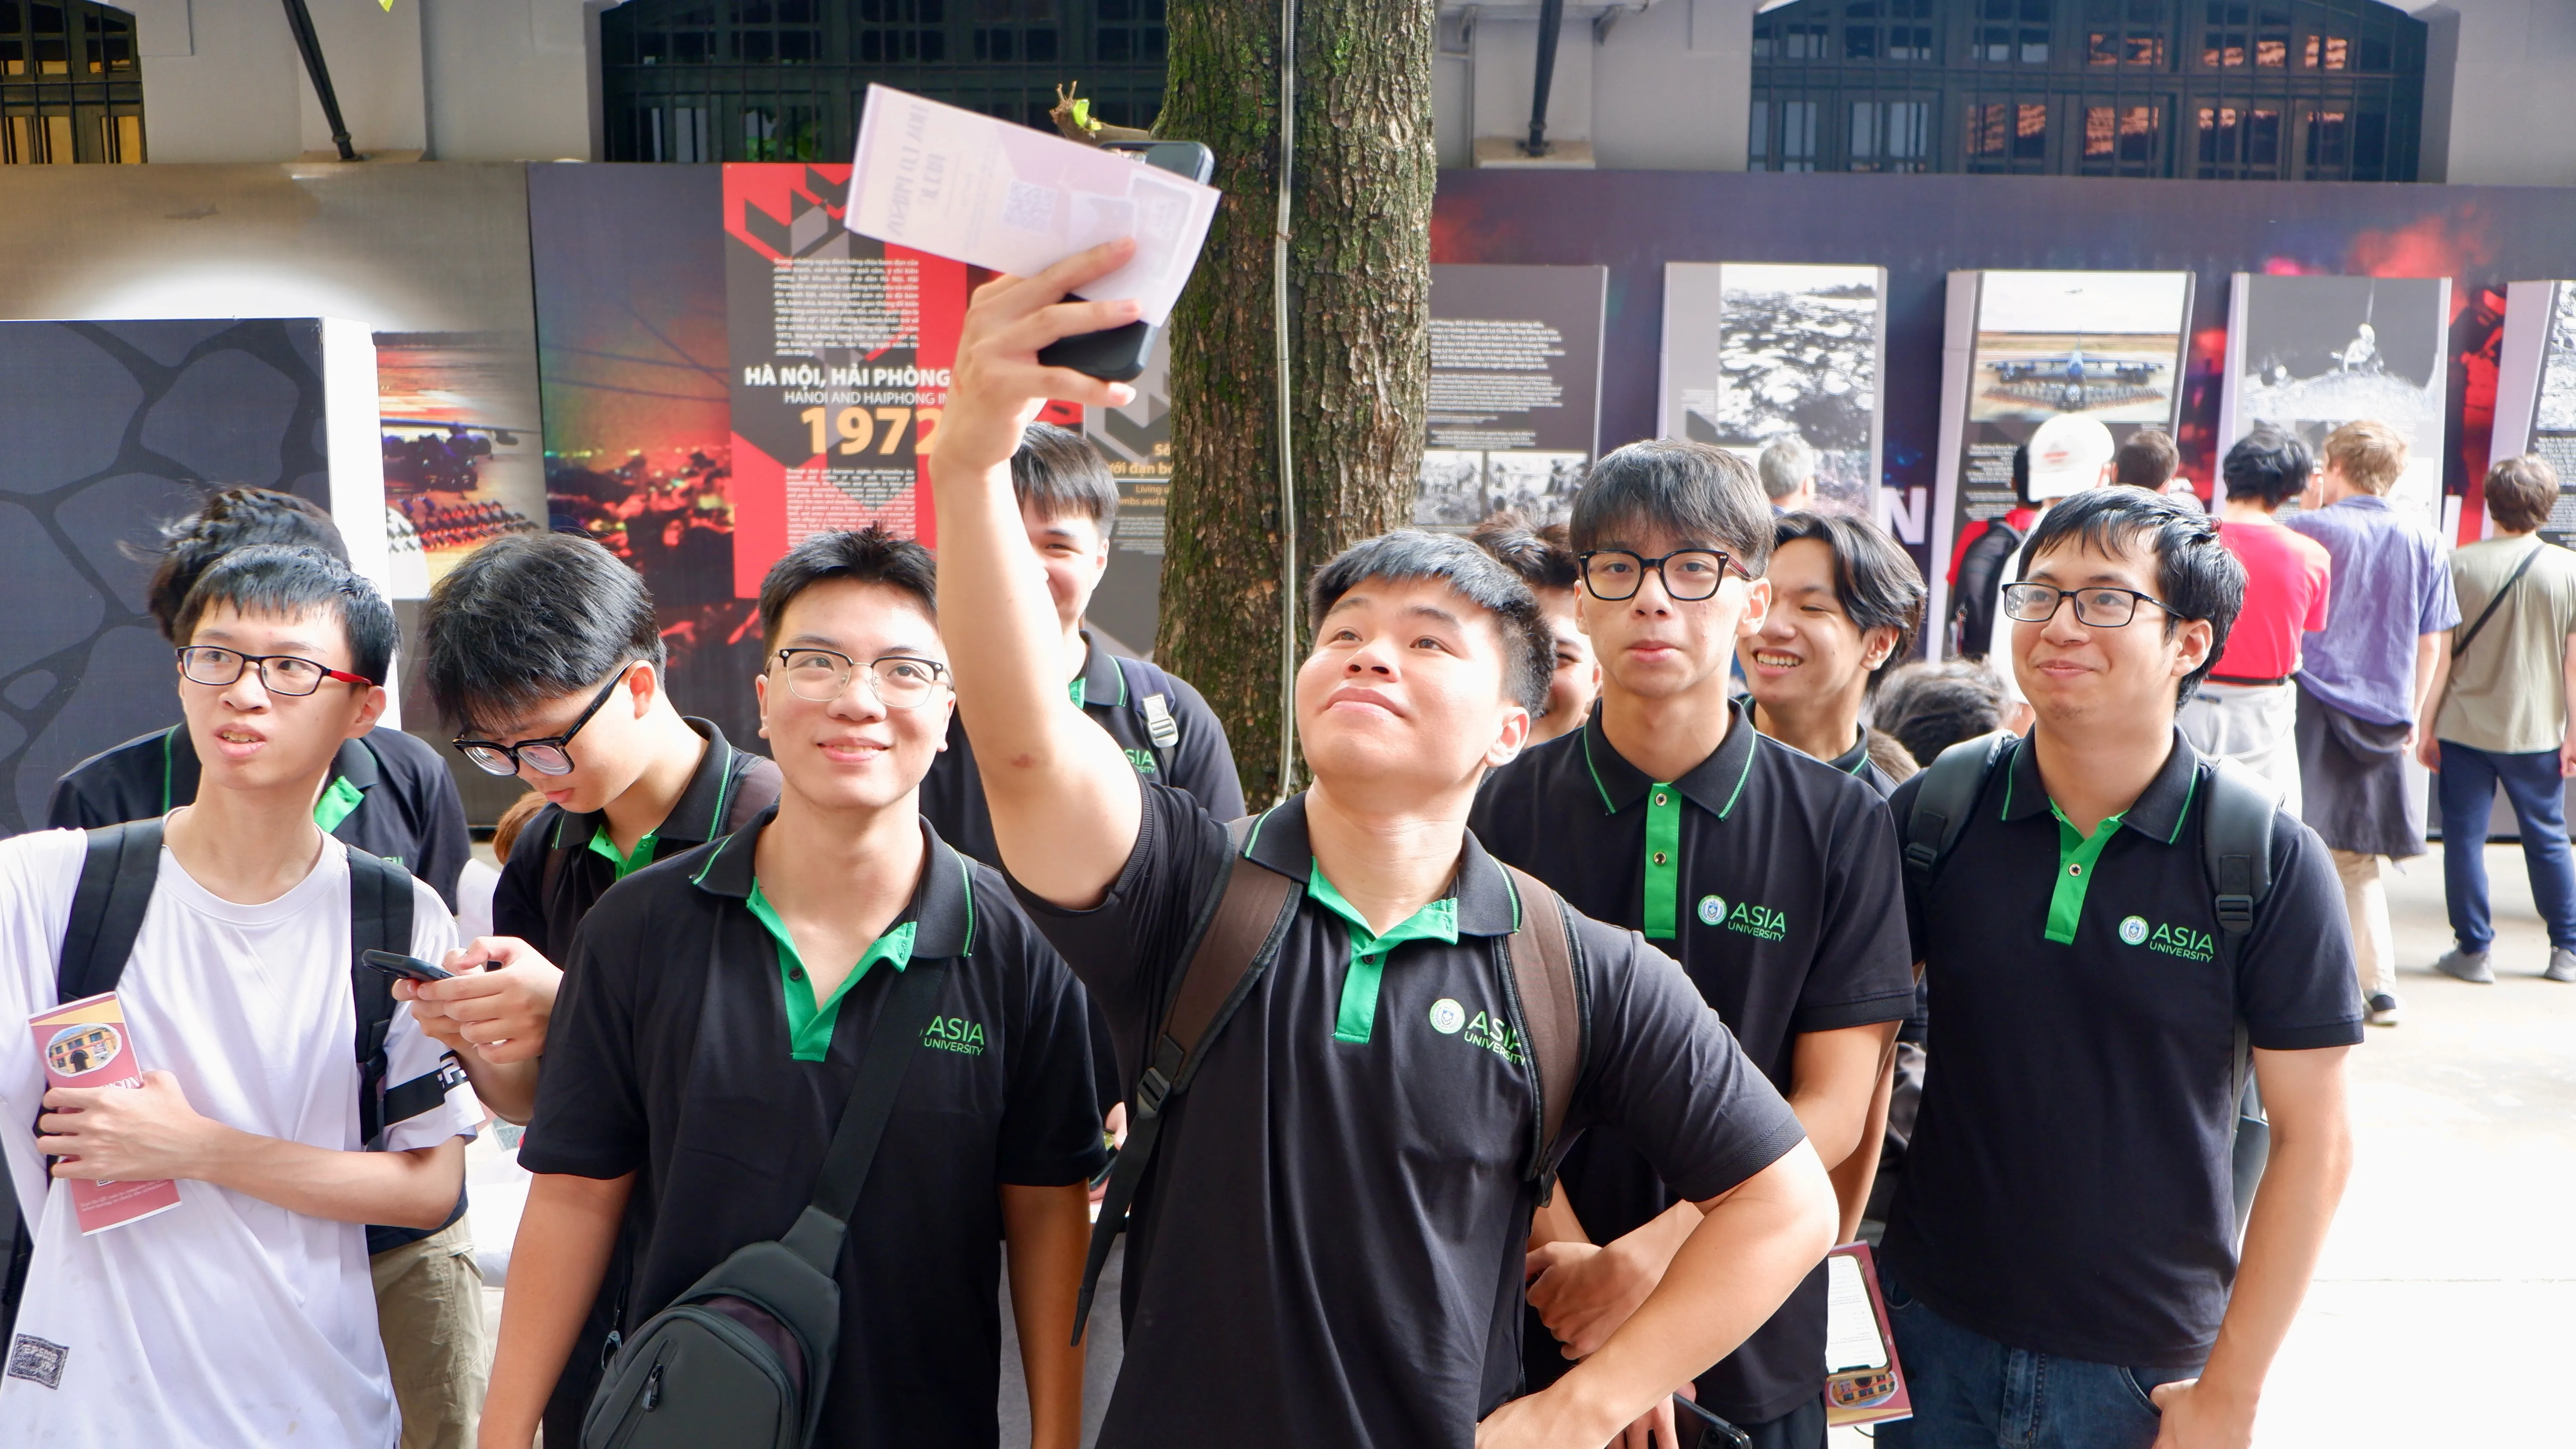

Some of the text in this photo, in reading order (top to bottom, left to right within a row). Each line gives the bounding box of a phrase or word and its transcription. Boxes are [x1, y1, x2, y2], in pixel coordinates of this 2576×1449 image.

[745, 363, 951, 391] HÀ NỘI, HẢI PHÒNG
[785, 392, 828, 404] HANOI
[832, 392, 860, 404] AND
[864, 392, 935, 405] HAIPHONG
[801, 407, 944, 455] 1972
[1130, 463, 1155, 477] đạn
[1136, 485, 1161, 495] Living
[1142, 497, 1158, 506] and
[1124, 749, 1155, 766] SIA
[1730, 902, 1785, 933] ASIA
[1728, 921, 1784, 942] UNIVERSITY
[2152, 923, 2214, 954] ASIA
[2149, 941, 2213, 963] UNIVERSITY
[926, 1016, 984, 1045] ASIA
[1467, 1011, 1521, 1049] ASIA
[924, 1037, 984, 1056] UNIVERSITY
[1464, 1031, 1525, 1066] UNIVERSITY
